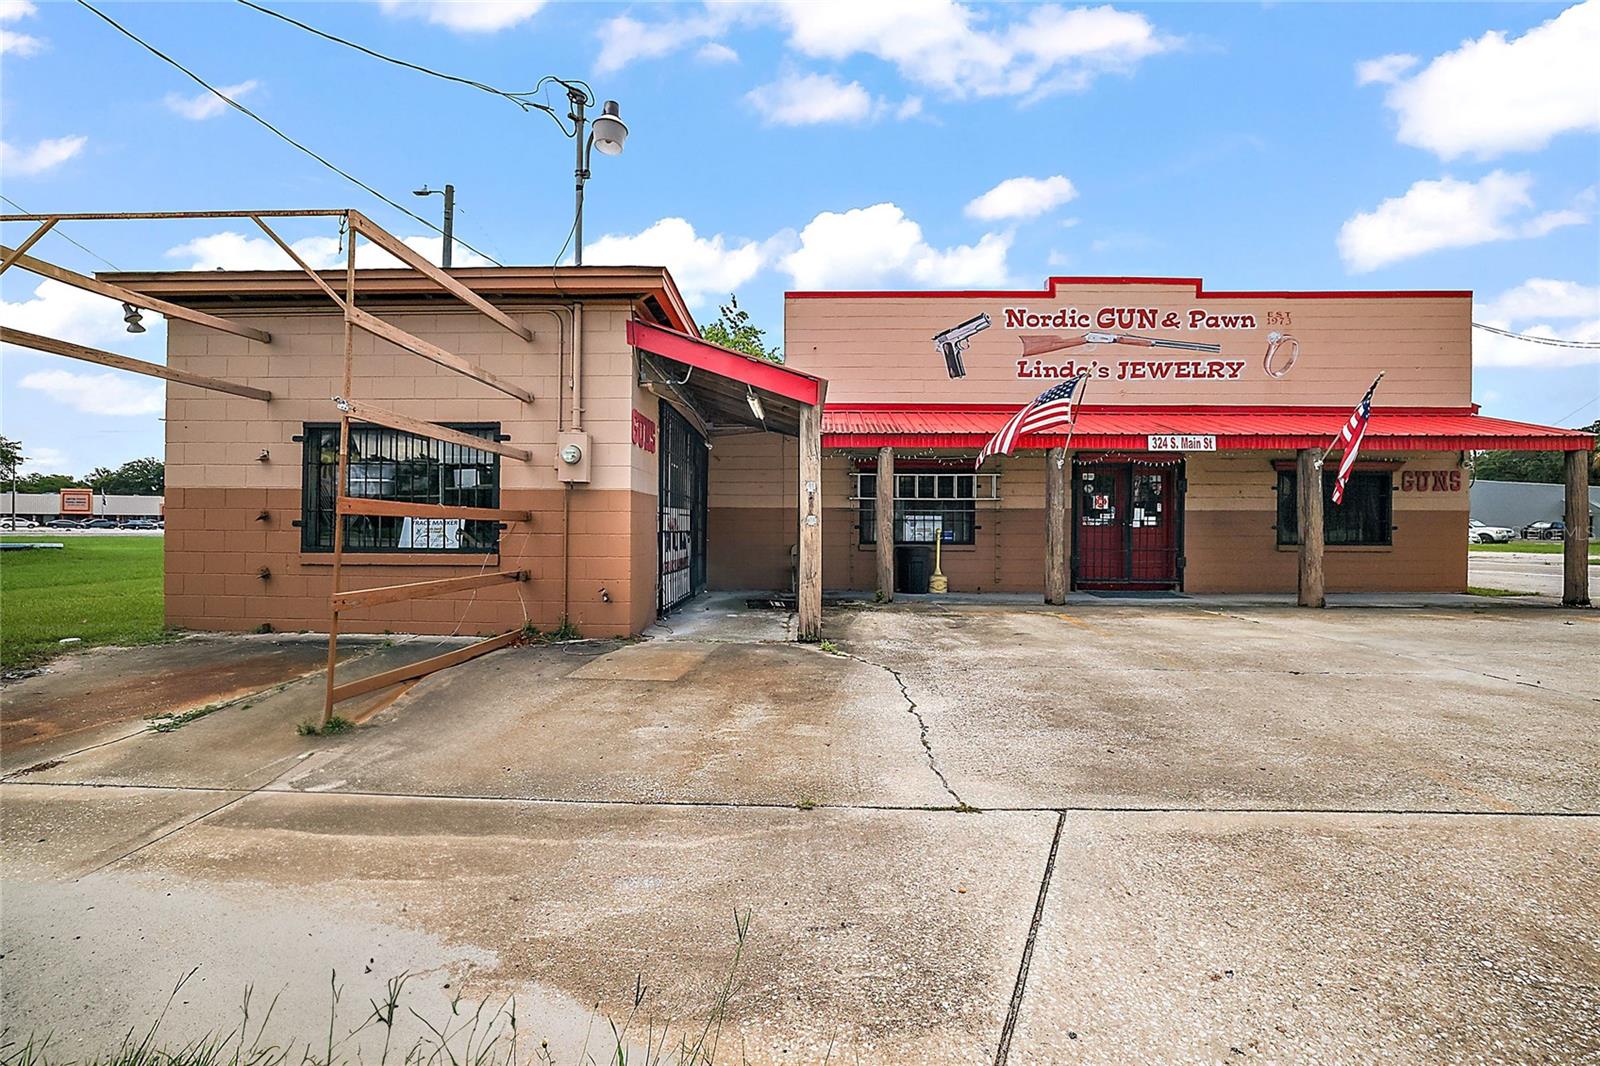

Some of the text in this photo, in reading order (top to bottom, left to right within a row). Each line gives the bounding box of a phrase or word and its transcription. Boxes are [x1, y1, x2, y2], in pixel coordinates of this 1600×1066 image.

[1004, 307, 1256, 329] Nordic GUN & Pawn
[1016, 360, 1245, 379] Linda's JEWELRY
[1152, 436, 1213, 449] 324 S. Main St
[1401, 470, 1461, 492] GUNS
